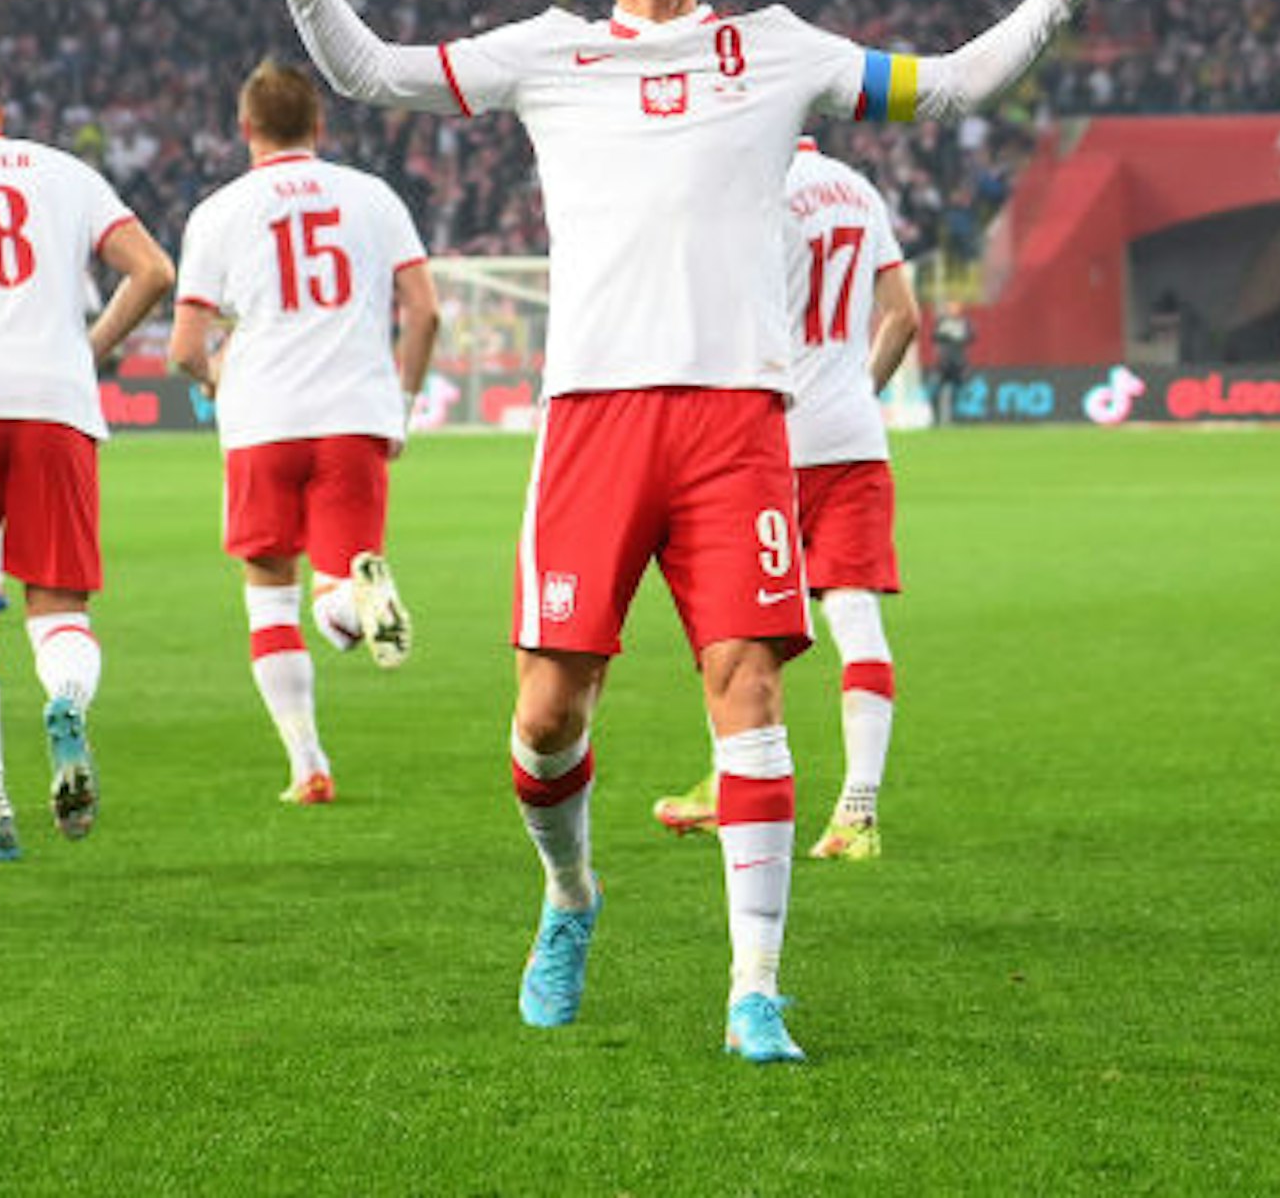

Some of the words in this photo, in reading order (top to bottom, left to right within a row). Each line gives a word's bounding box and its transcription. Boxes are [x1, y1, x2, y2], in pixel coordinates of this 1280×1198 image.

[269, 204, 353, 312] 15
[804, 226, 865, 345] 17
[997, 382, 1054, 416] na
[756, 509, 791, 577] 9
